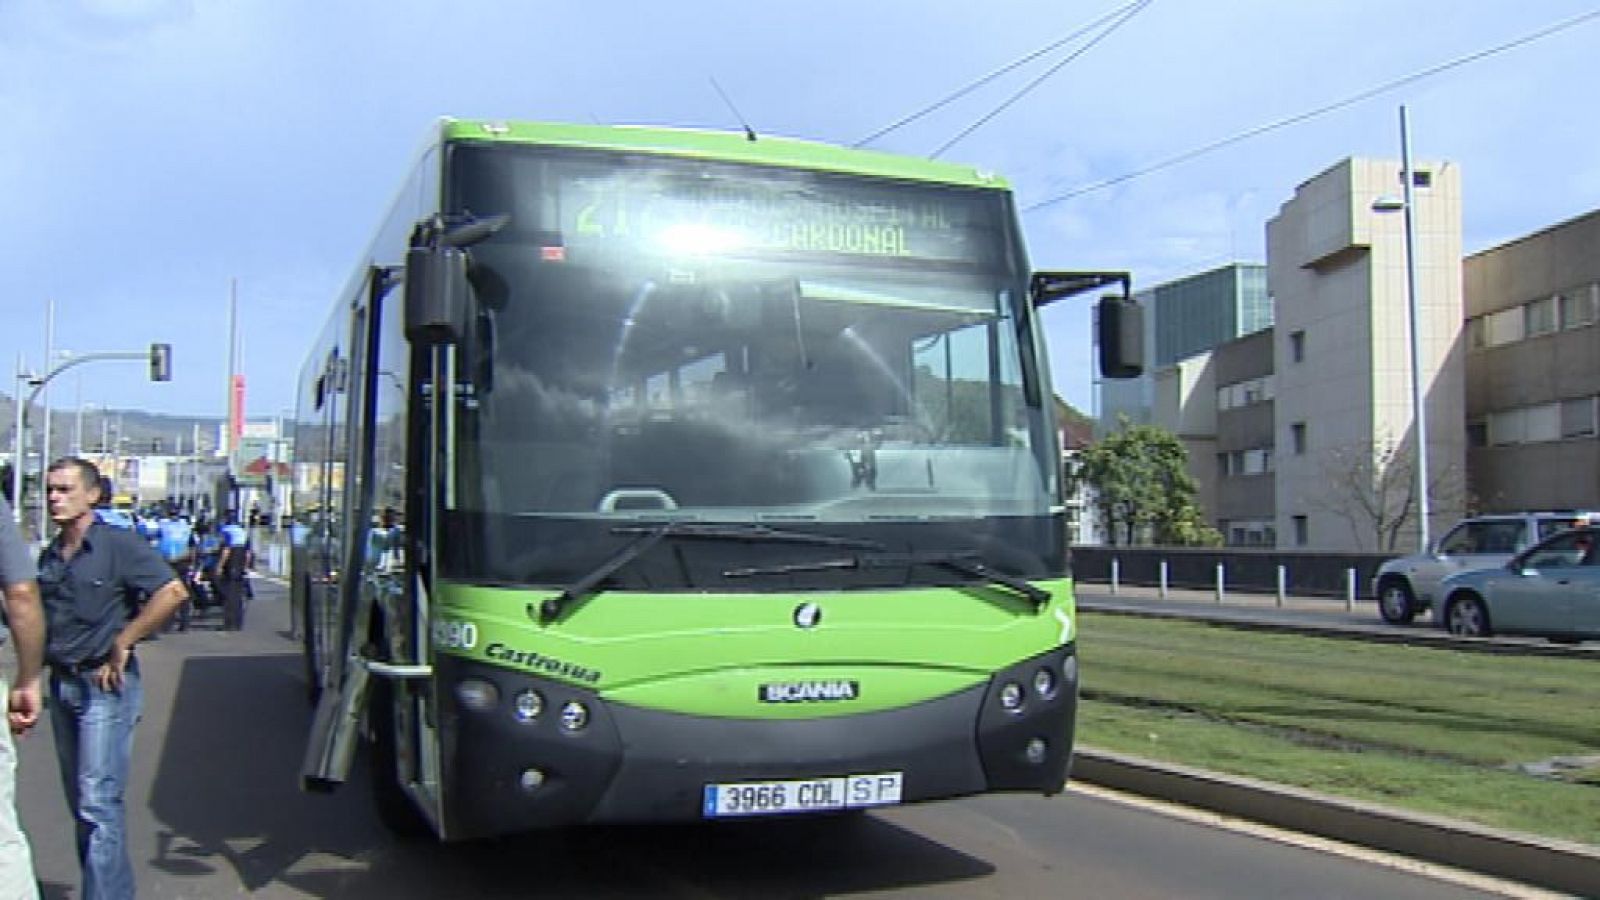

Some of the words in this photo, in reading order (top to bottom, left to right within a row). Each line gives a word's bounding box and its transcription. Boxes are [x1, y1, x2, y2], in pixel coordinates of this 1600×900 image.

[485, 643, 601, 683] Castrosua
[766, 681, 854, 701] SCANIA
[726, 784, 786, 811] 3966
[798, 781, 840, 807] CDL
